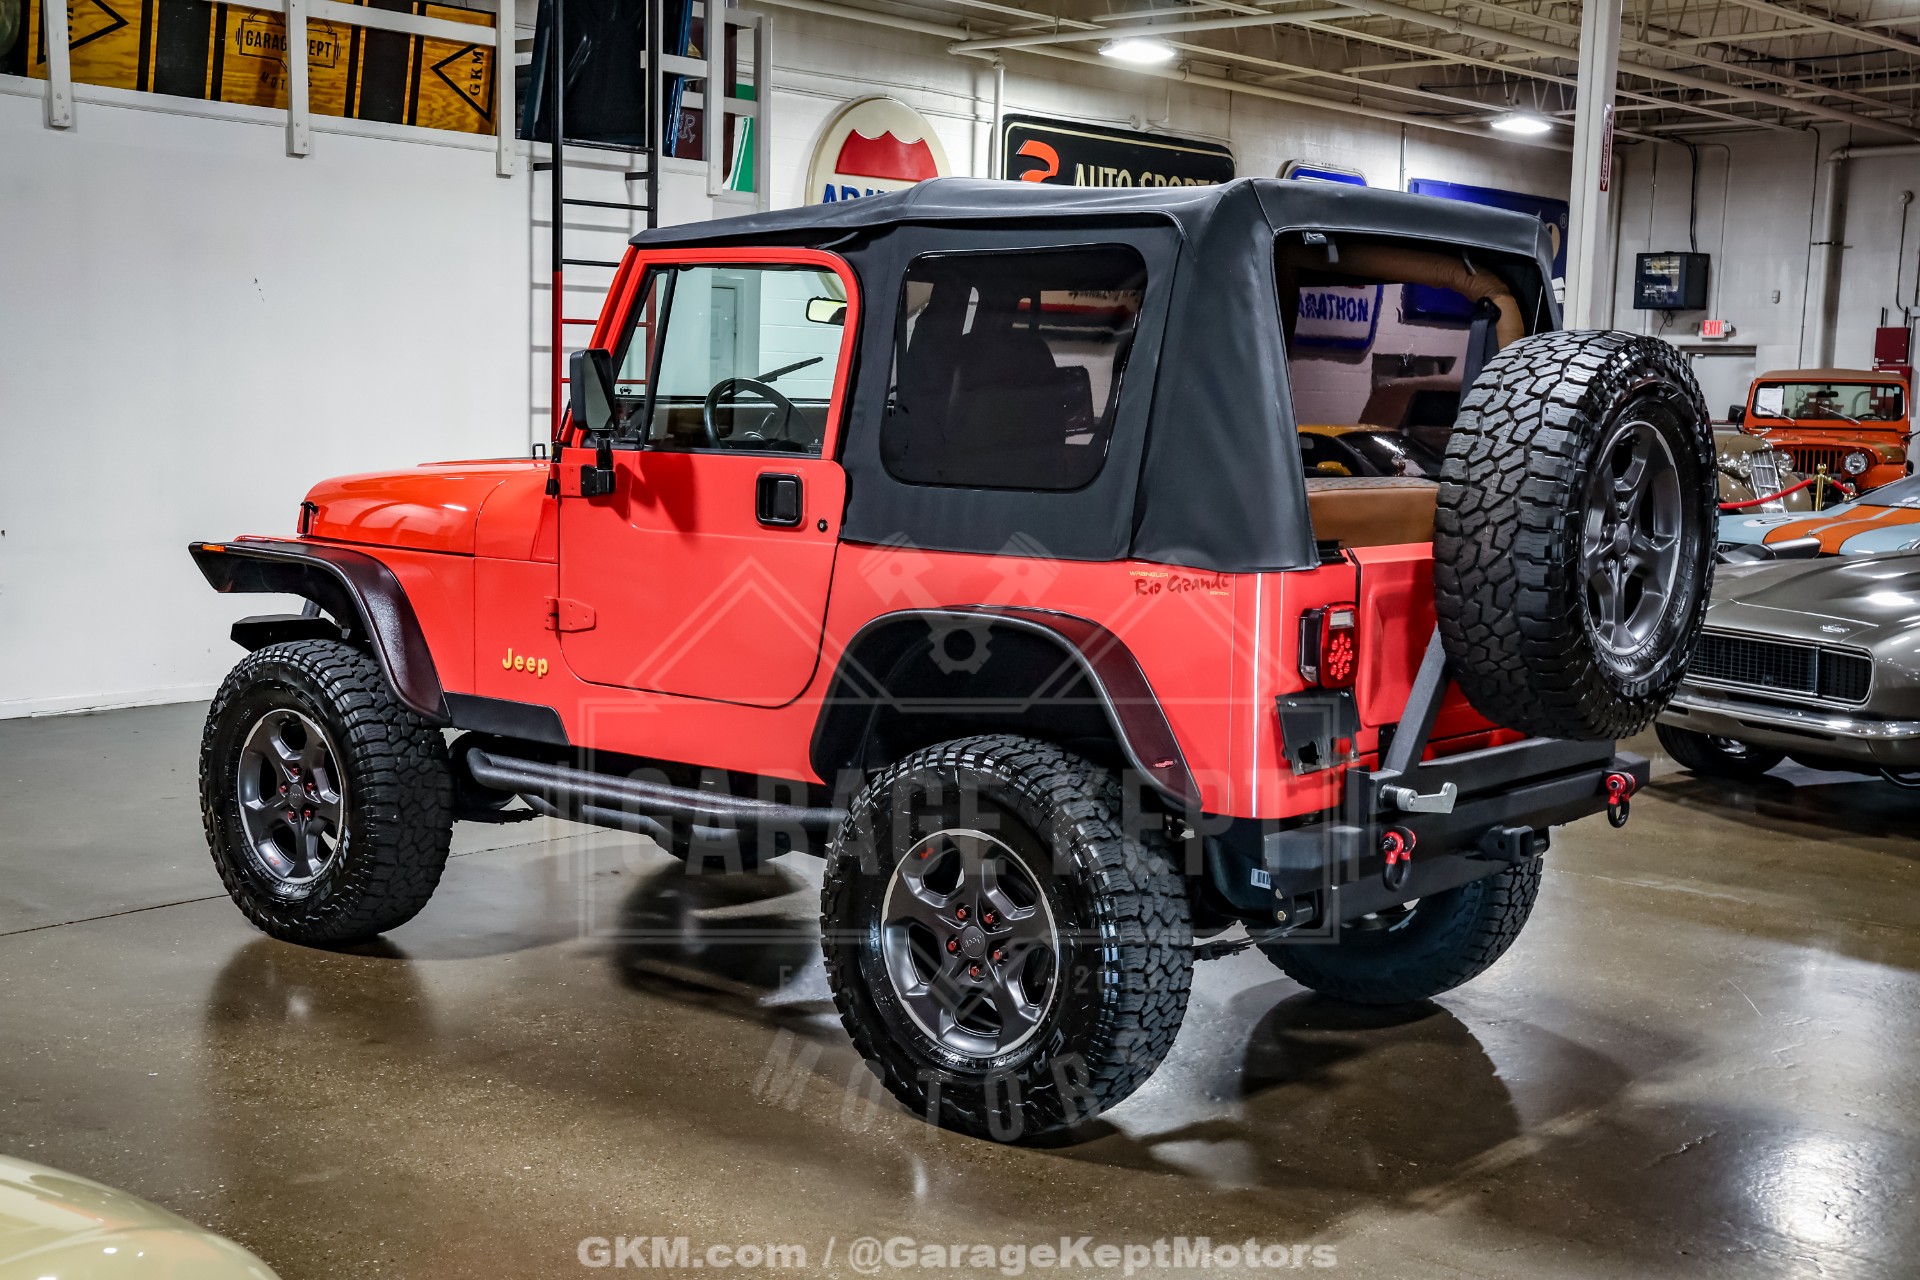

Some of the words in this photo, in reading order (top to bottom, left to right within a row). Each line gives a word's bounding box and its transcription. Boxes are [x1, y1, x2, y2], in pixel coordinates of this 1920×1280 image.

[244, 29, 288, 52] GARAG
[307, 38, 332, 58] EPT
[468, 50, 485, 96] GKM
[1298, 292, 1369, 322] ARATHON
[1703, 319, 1724, 336] EXIT
[1134, 577, 1162, 596] Rio
[1166, 573, 1229, 594] Grande
[502, 647, 549, 680] Jeep
